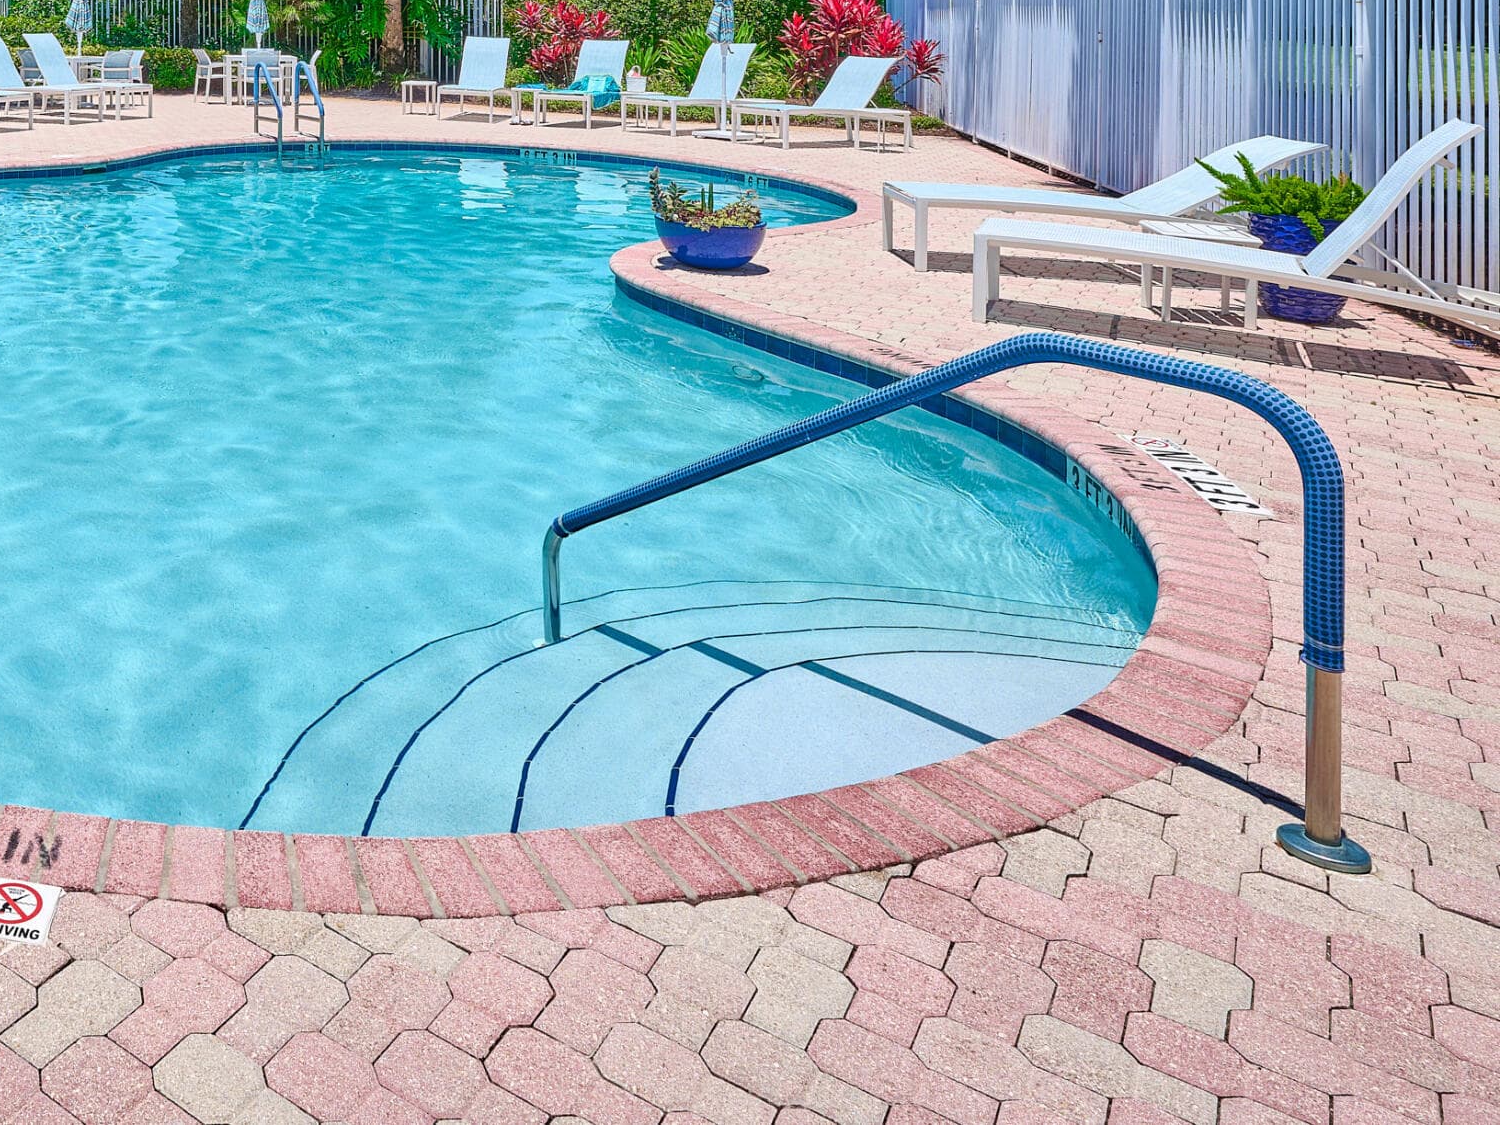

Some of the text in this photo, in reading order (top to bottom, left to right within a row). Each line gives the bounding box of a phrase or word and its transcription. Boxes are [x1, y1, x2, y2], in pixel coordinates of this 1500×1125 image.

[534, 151, 548, 160] FT
[563, 152, 575, 160] IN
[756, 177, 768, 186] FT
[1145, 448, 1261, 510] 3 FT 3 IN
[1072, 465, 1080, 491] 3
[1085, 474, 1102, 508] FT
[1118, 504, 1132, 539] IN
[2, 827, 63, 869] IN
